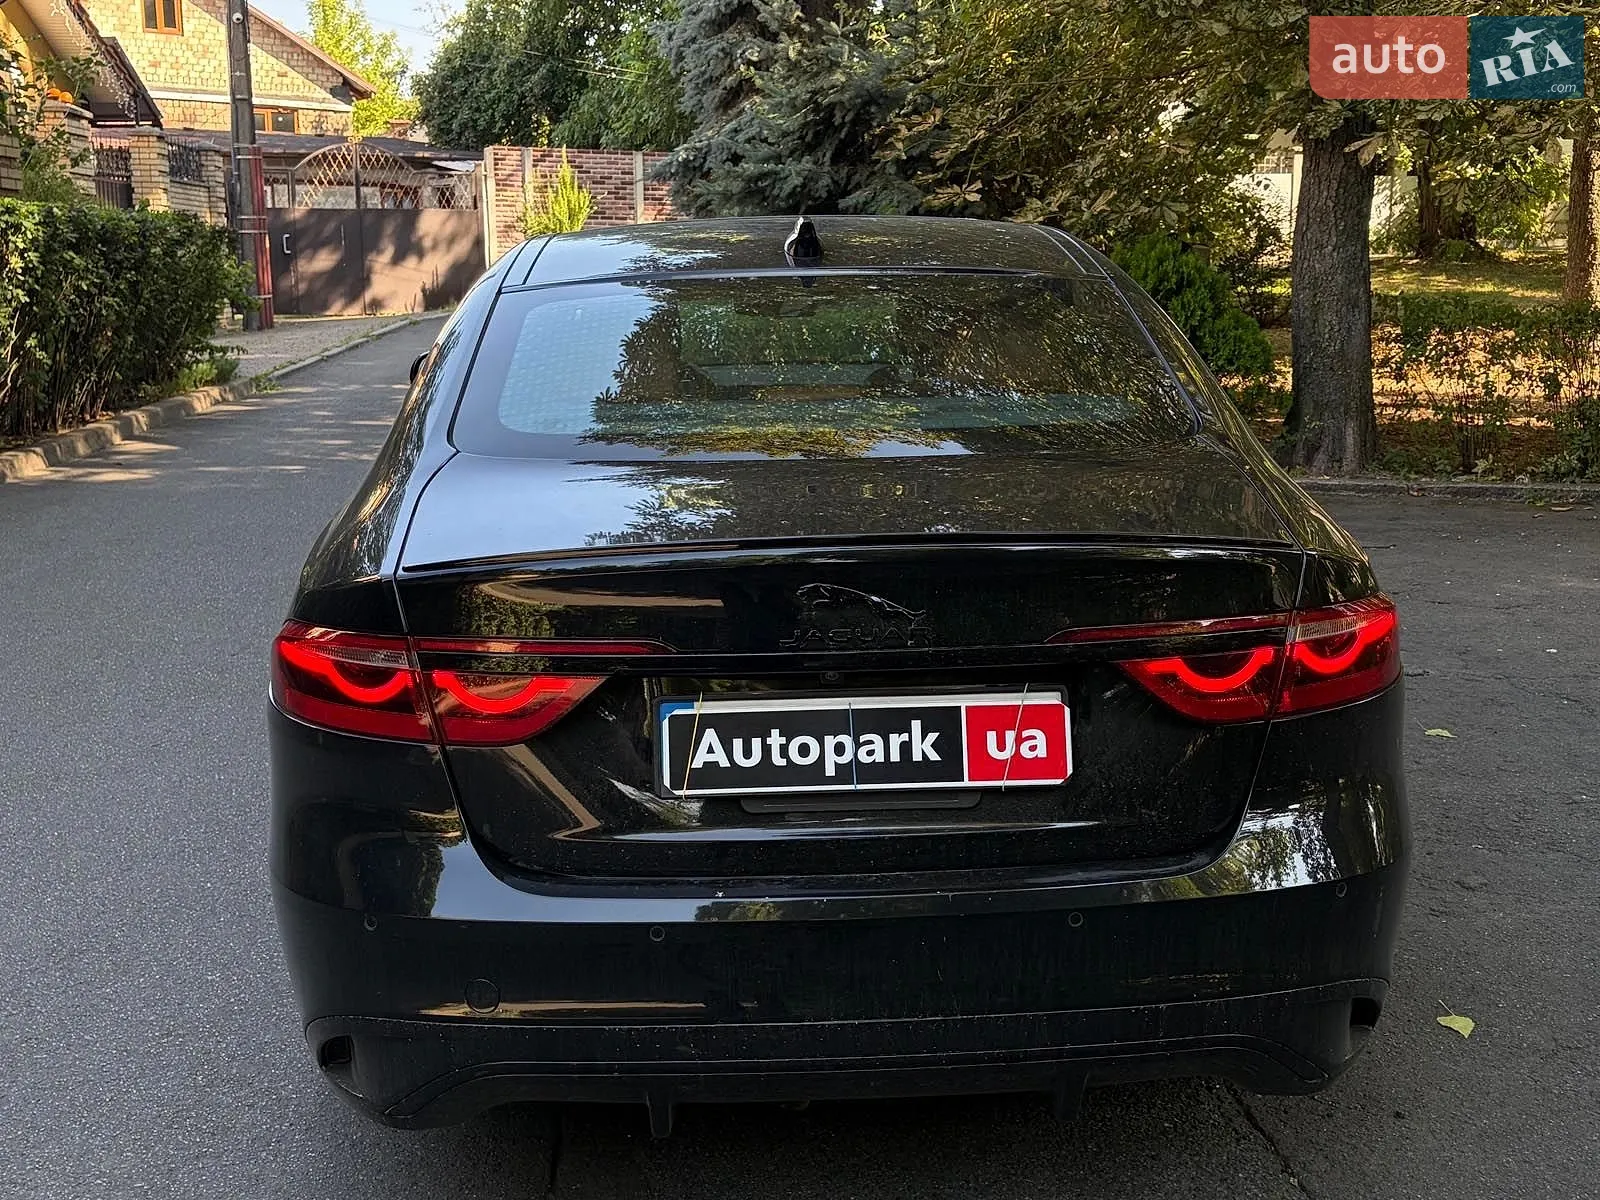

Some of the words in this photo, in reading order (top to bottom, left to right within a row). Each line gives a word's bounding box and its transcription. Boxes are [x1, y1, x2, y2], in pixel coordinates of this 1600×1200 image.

[778, 626, 933, 649] JAGUAR
[691, 719, 942, 778] Autopark
[985, 728, 1048, 760] ua
